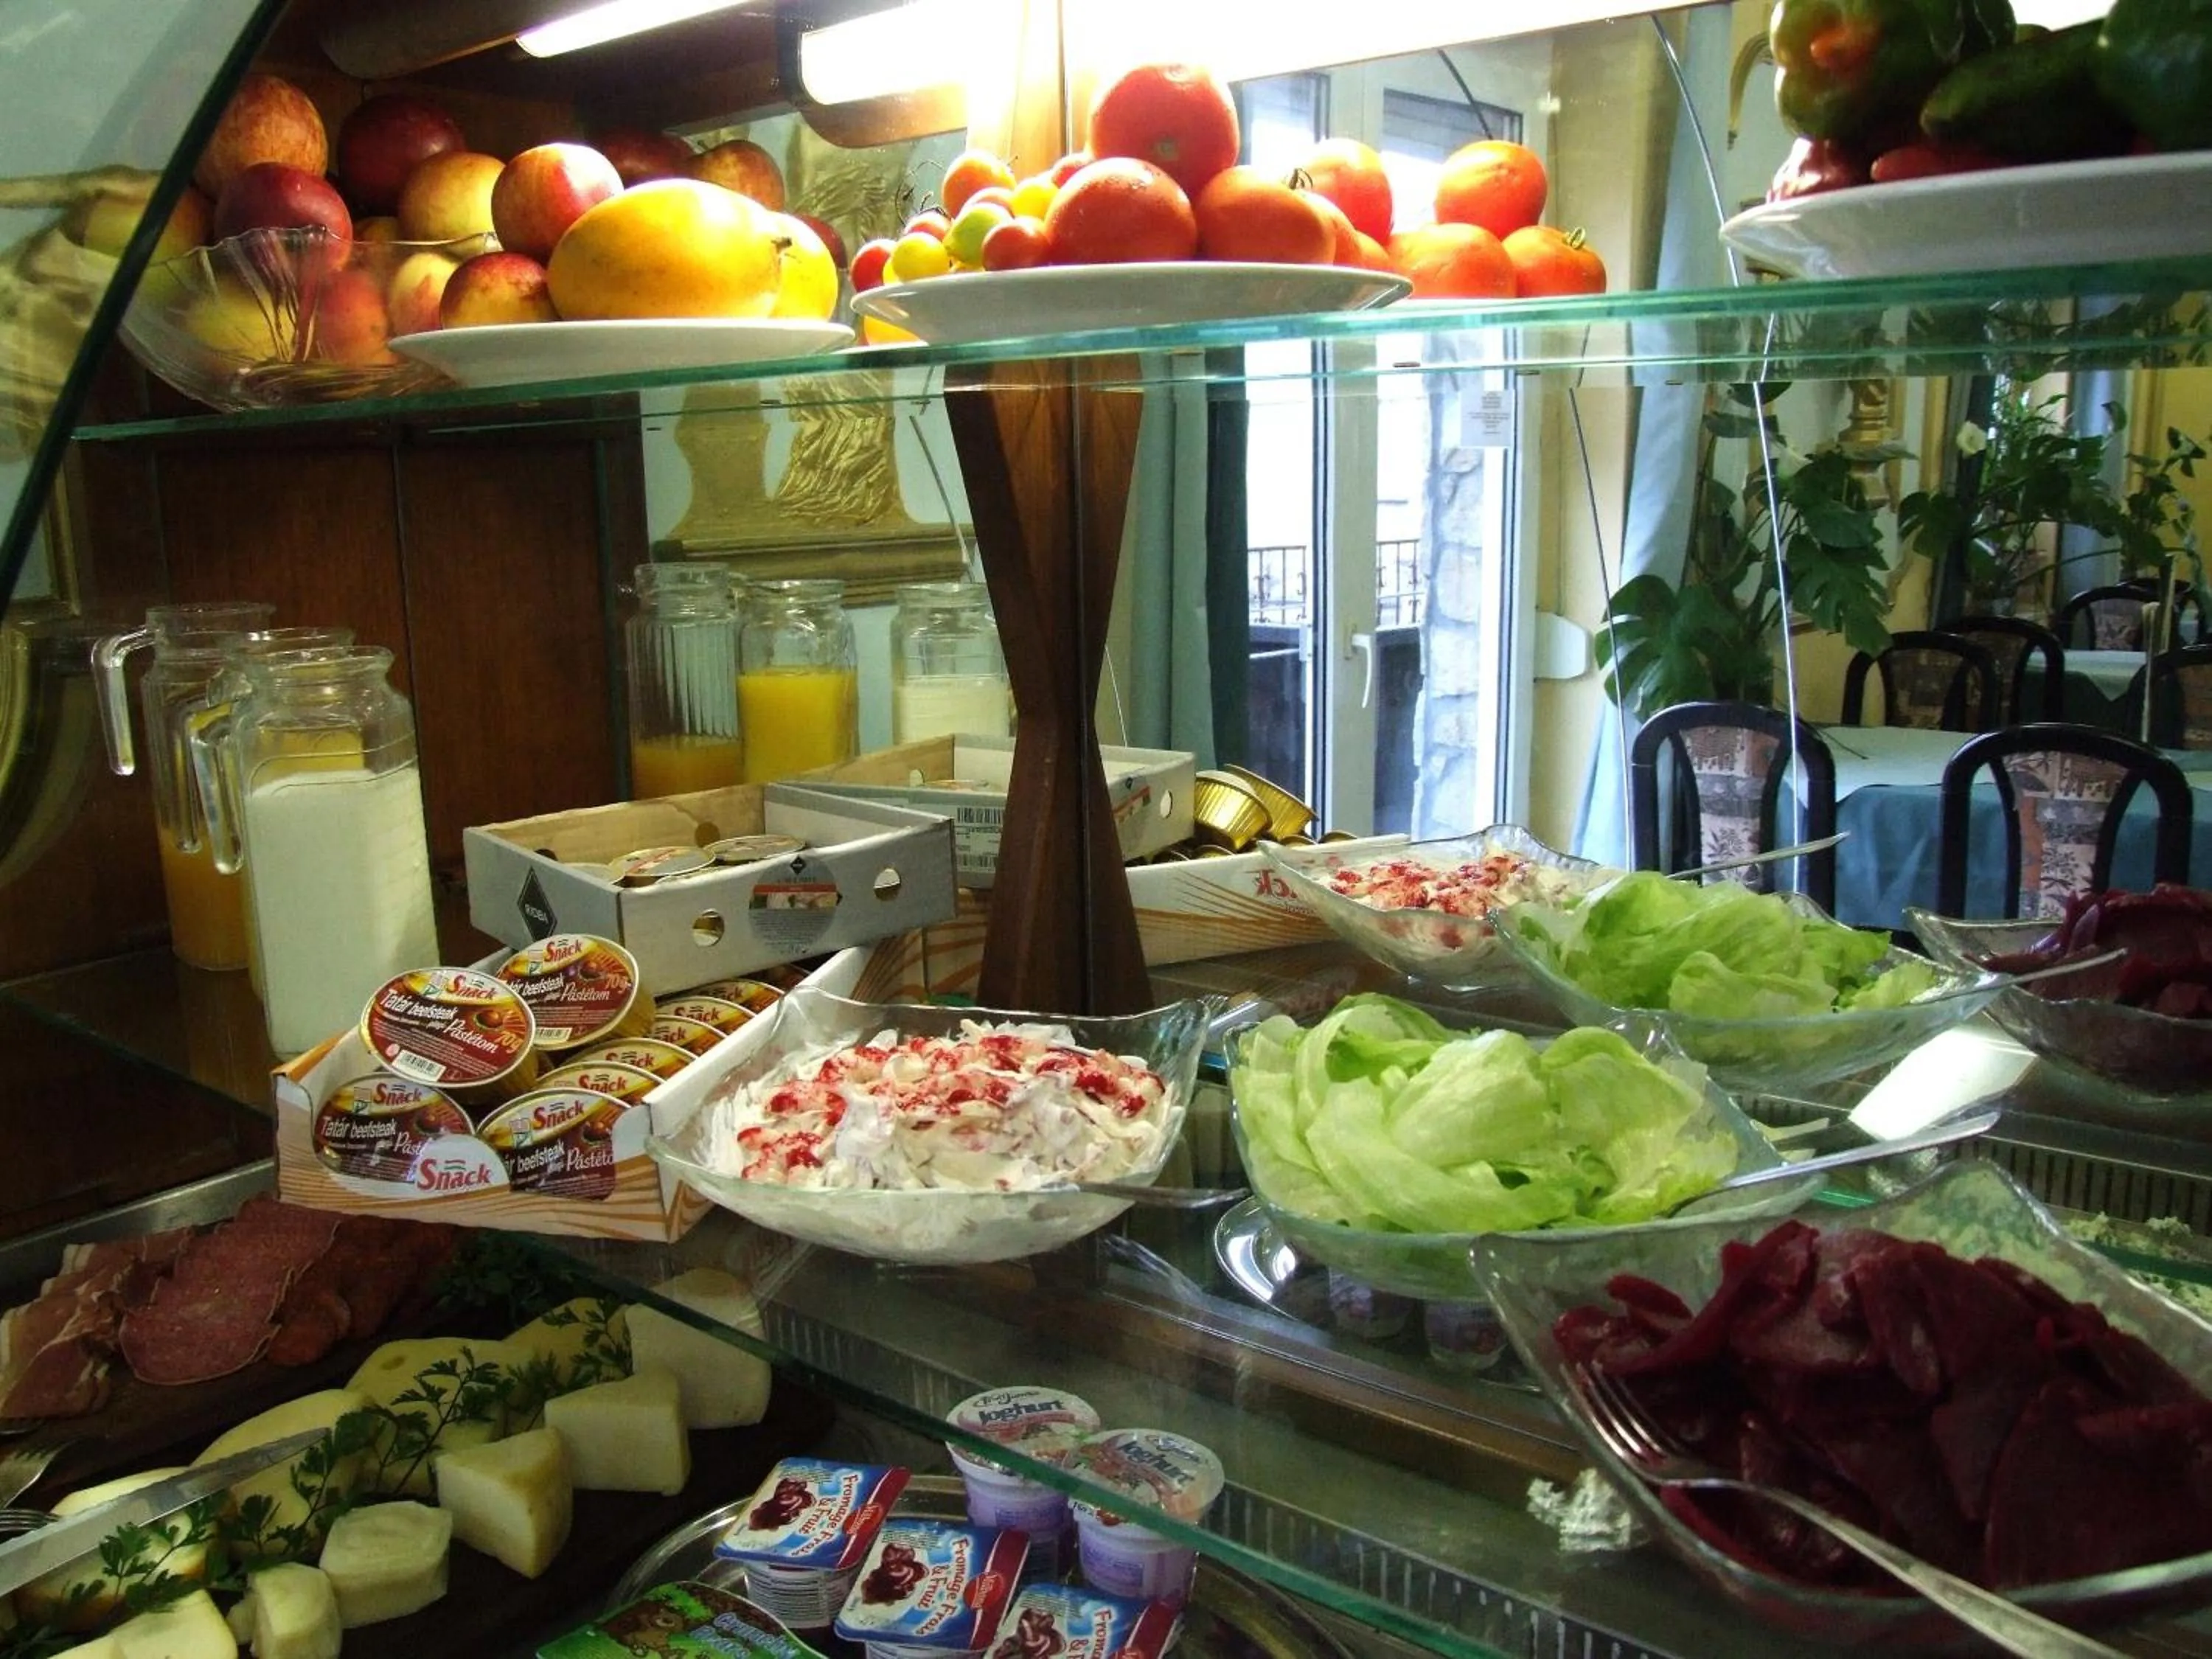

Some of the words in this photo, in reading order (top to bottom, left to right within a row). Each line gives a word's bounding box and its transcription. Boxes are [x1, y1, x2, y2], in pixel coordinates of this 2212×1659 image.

[544, 939, 582, 961] Snack
[446, 974, 498, 1000] Snack
[380, 989, 411, 1012] Tatár
[408, 1001, 458, 1020] beefsteak
[443, 1018, 499, 1054] Pástétom
[374, 1082, 422, 1105] Snack
[321, 1115, 351, 1138] Tatár
[349, 1117, 397, 1139] beefsteak
[532, 1099, 585, 1128] Snack
[517, 1138, 566, 1173] beefsteak
[417, 1158, 492, 1191] Snack
[828, 1474, 860, 1528] Fromage
[799, 1507, 833, 1534] Fruit
[946, 1538, 970, 1601] Fromage
[917, 1576, 948, 1609] Fruit
